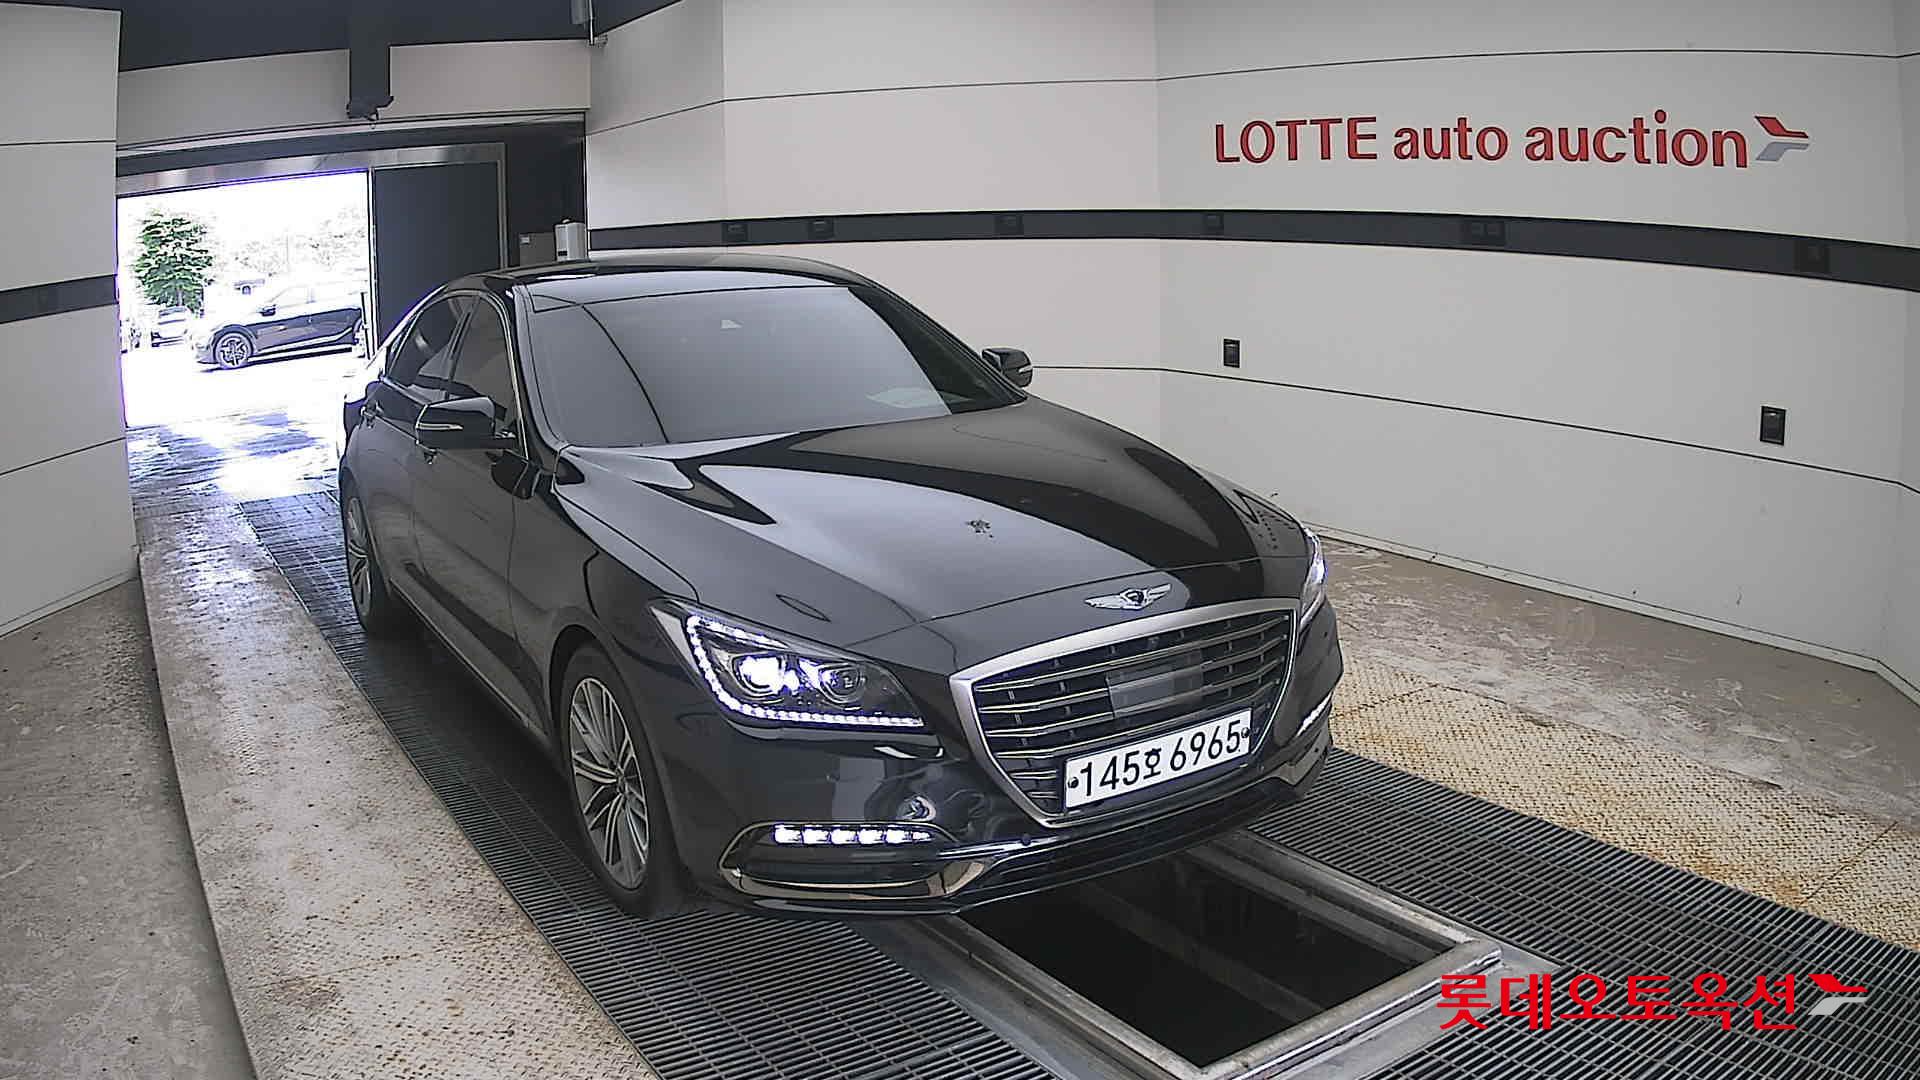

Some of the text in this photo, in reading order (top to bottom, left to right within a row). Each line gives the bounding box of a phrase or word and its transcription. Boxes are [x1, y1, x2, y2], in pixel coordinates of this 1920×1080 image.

[1215, 109, 1748, 168] LOTTE auto auction
[1080, 720, 1241, 796] 145호 6965
